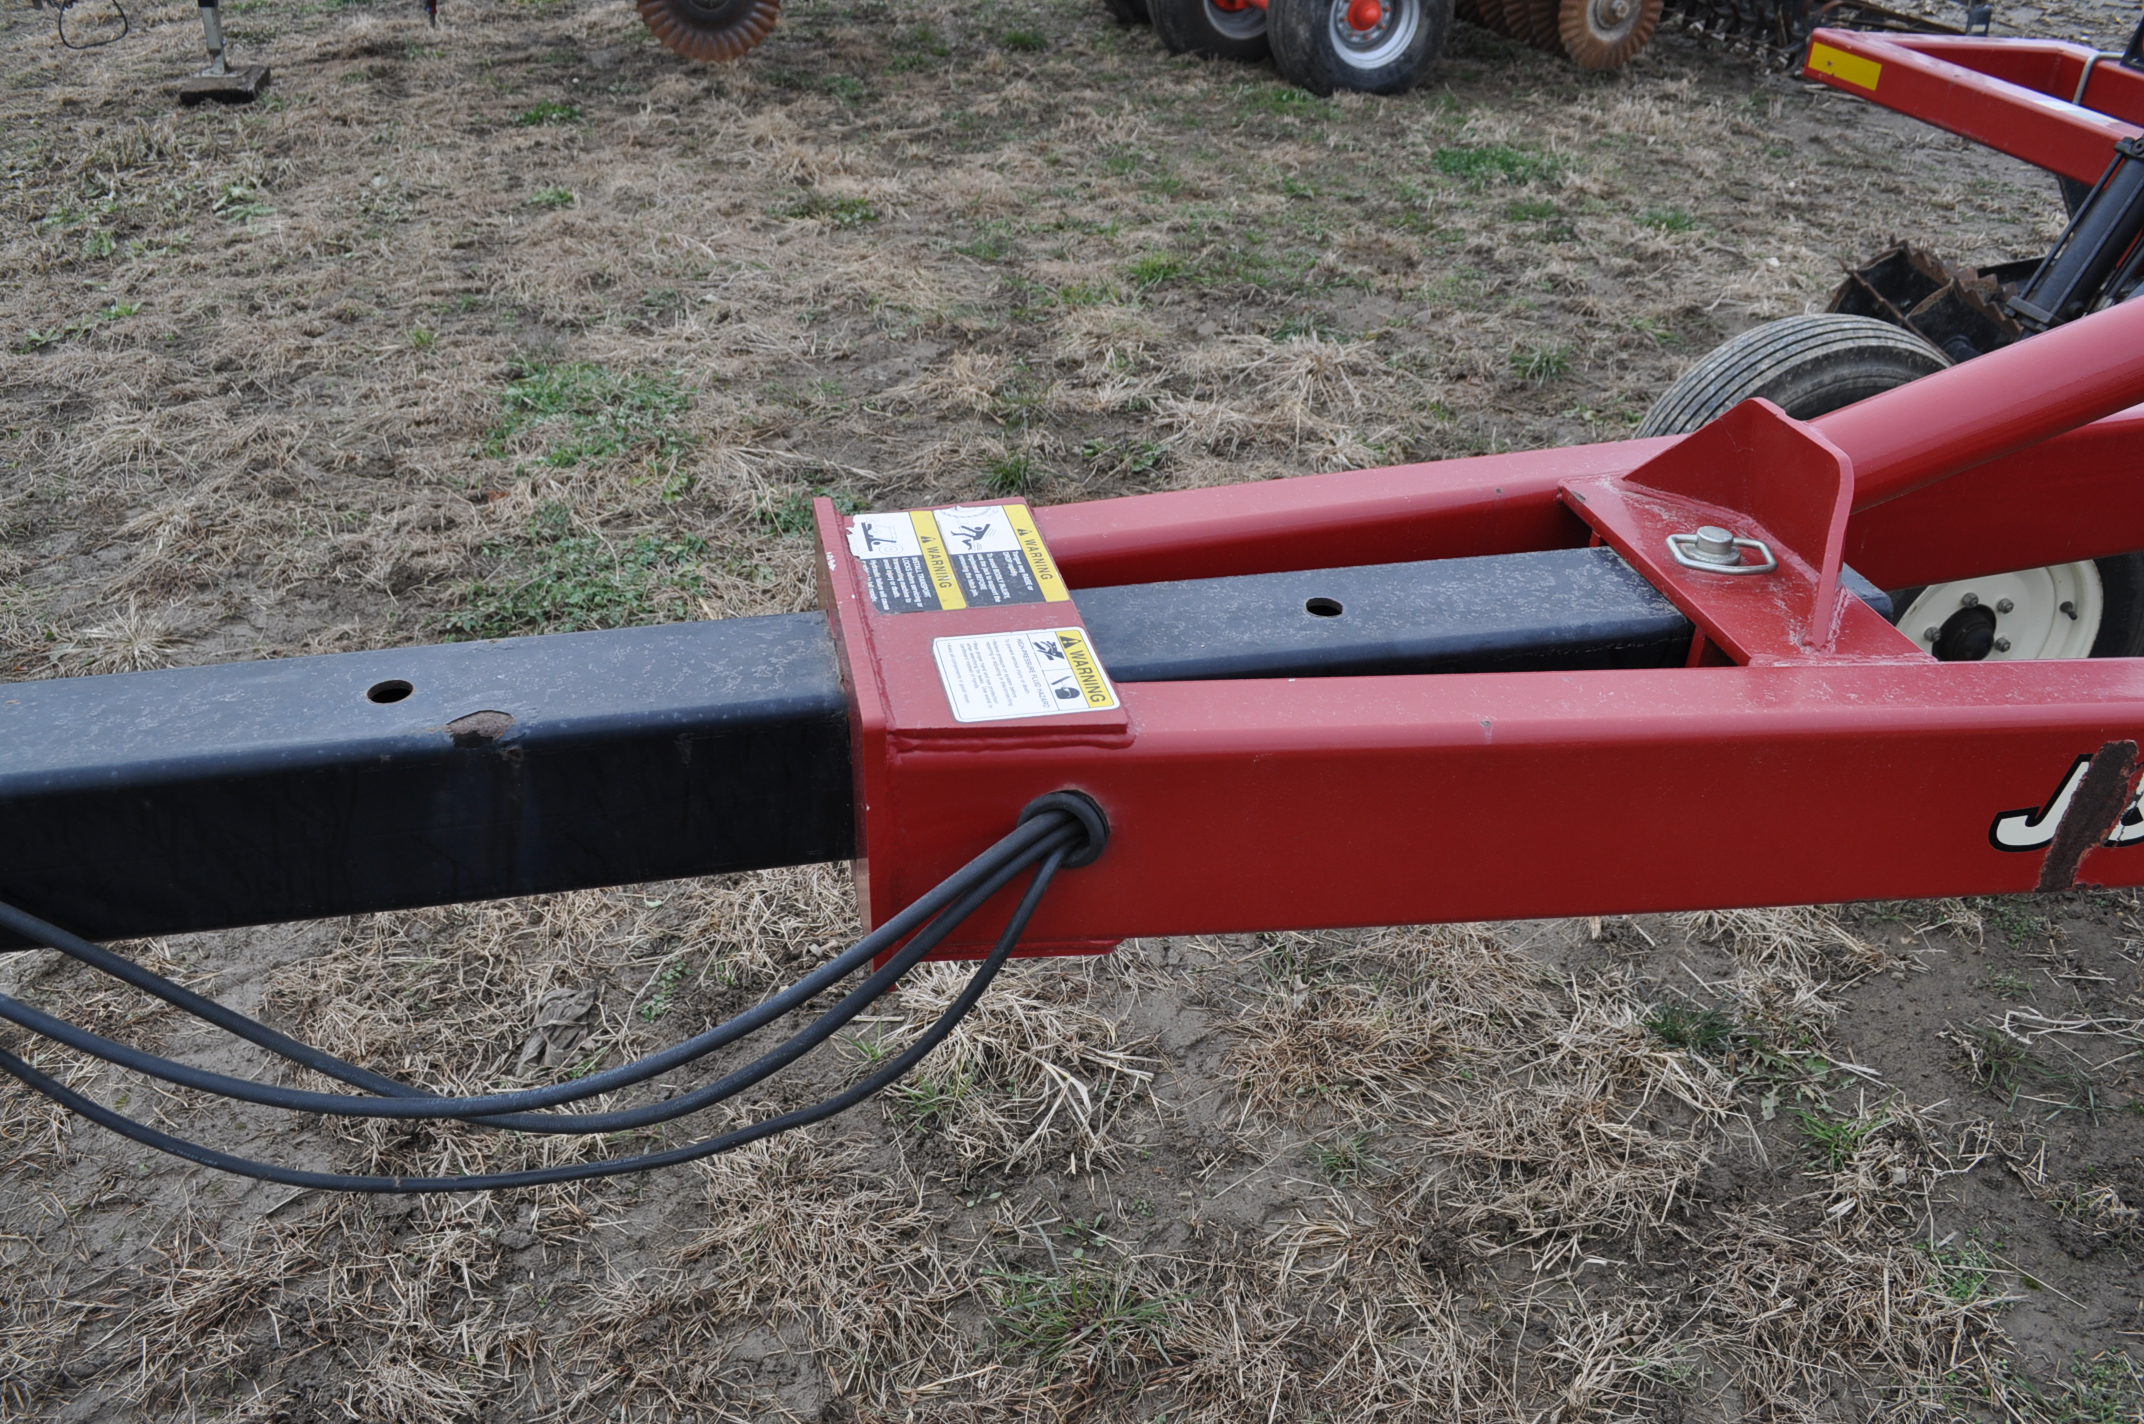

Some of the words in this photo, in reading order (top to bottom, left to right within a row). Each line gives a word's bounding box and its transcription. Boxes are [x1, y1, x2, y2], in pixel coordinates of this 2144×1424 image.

[926, 546, 952, 588] WARNING
[1023, 538, 1053, 580] WARNING
[1068, 650, 1107, 702] WARNING
